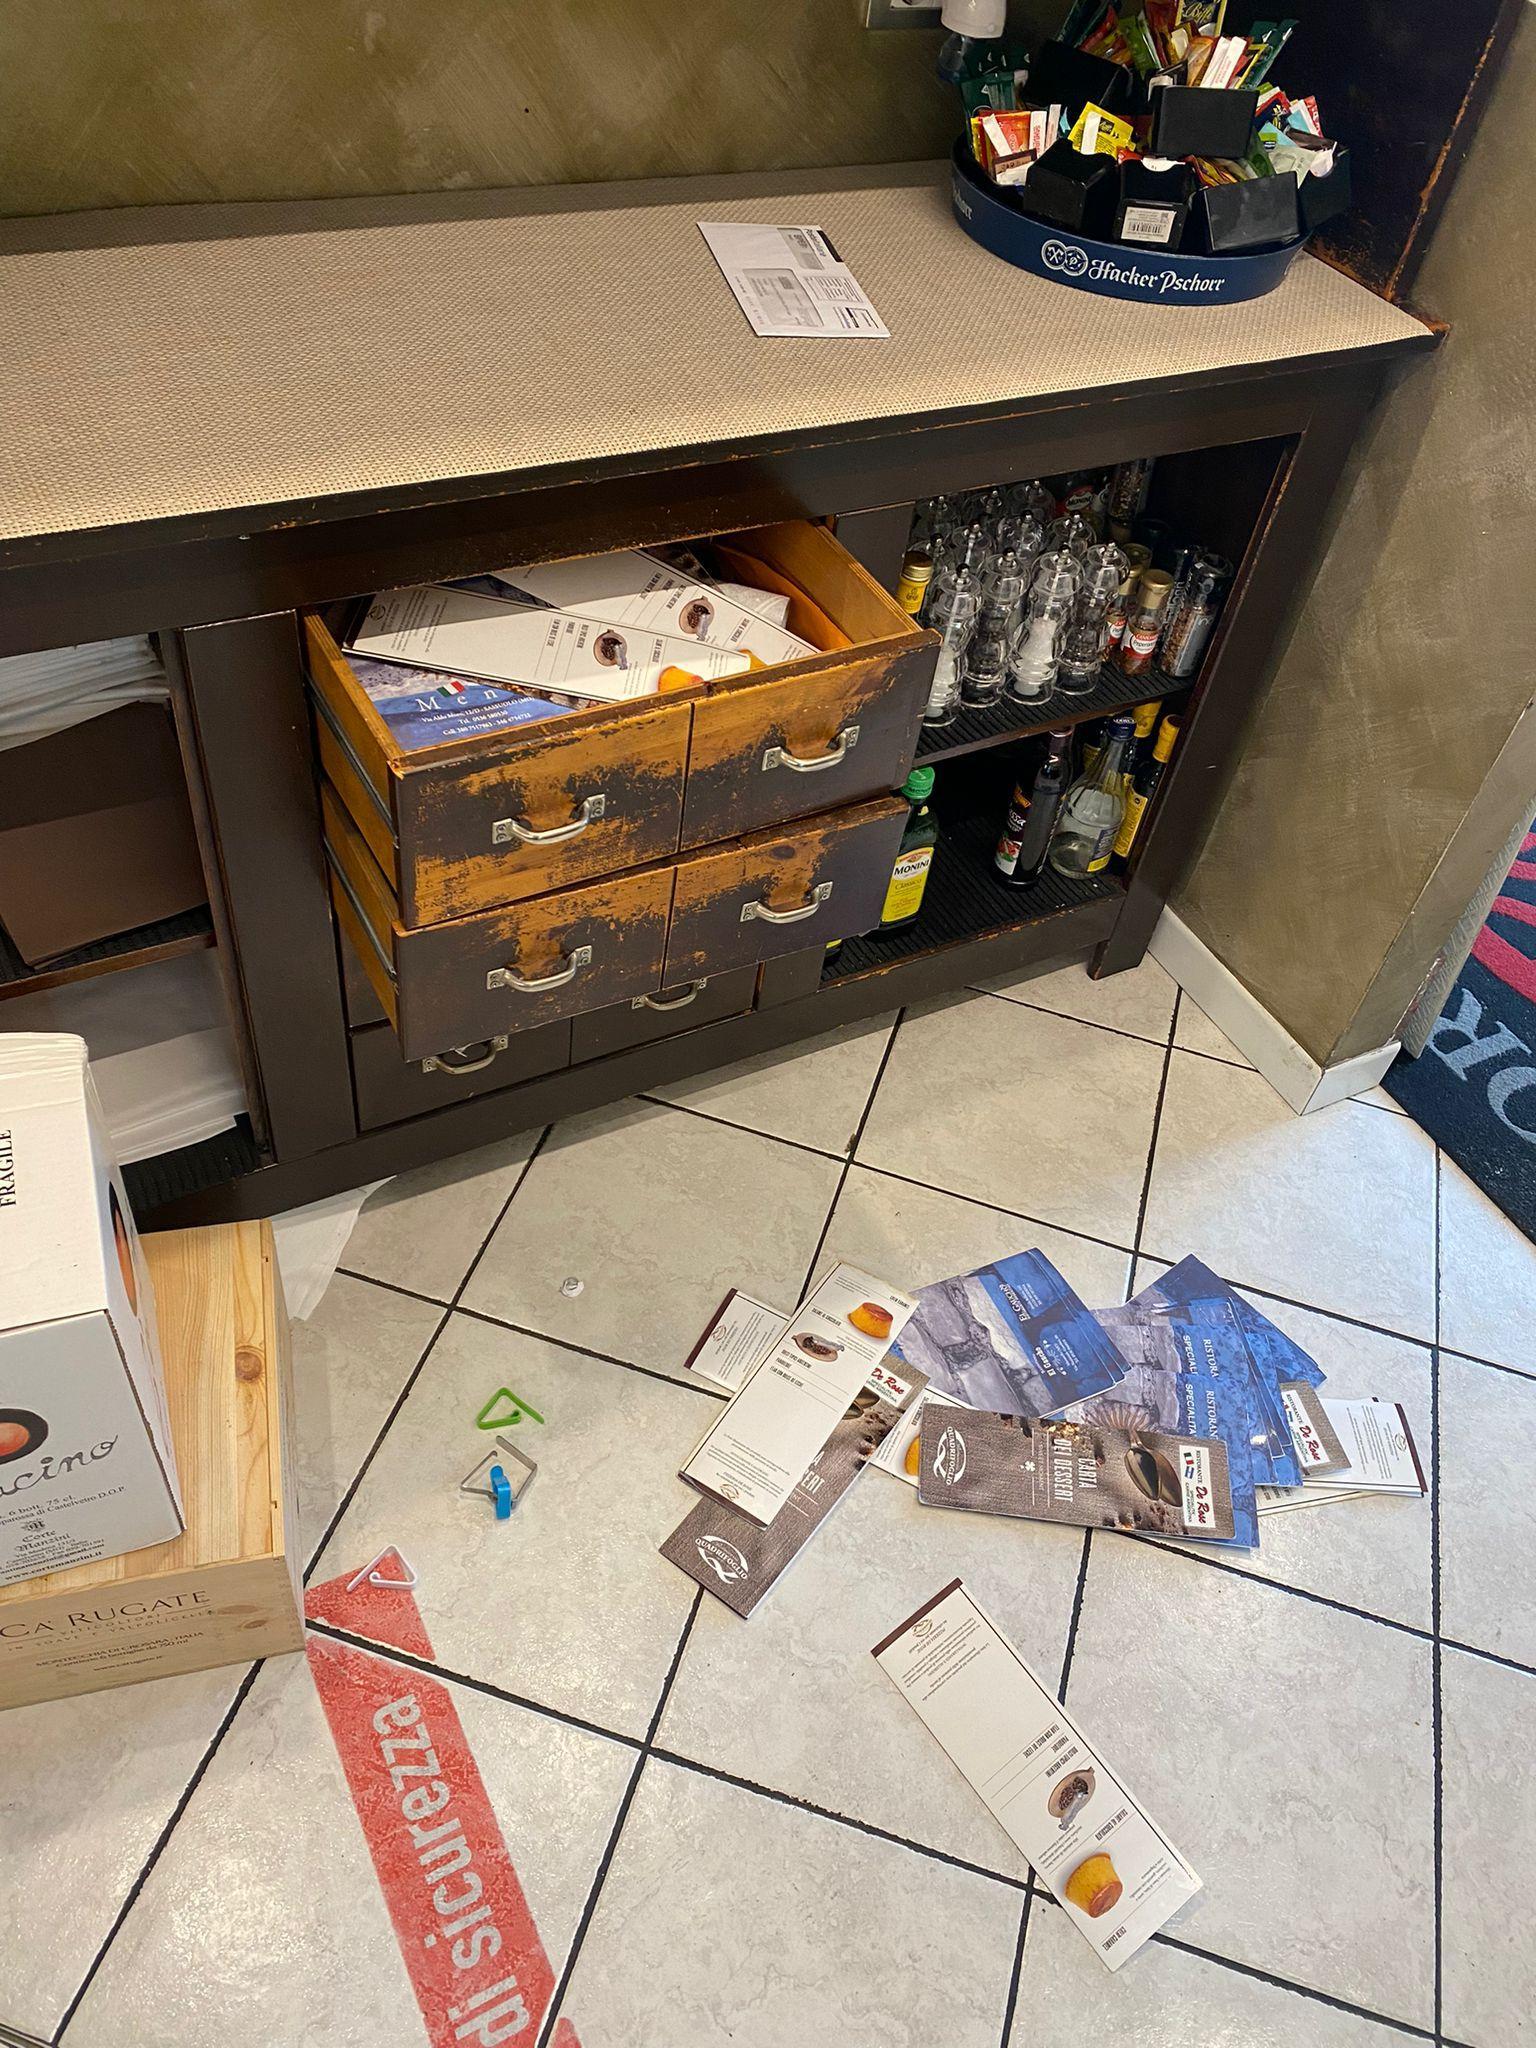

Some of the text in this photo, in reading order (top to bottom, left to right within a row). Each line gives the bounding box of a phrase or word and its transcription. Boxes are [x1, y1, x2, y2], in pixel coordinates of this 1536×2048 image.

[1088, 259, 1226, 294] Hacker Pschorr
[894, 859, 930, 876] MONINI
[0, 1129, 16, 1207] FRAGILE
[871, 1367, 905, 1395] De Rose
[946, 1426, 957, 1486] QUADRIFOGLIO
[1299, 1425, 1311, 1438] De
[1306, 1440, 1321, 1461] Rose
[1053, 1438, 1074, 1503] DEI DESSERT
[1078, 1457, 1098, 1489] CARTA
[1195, 1486, 1208, 1500] De
[1197, 1501, 1210, 1524] Rose
[14, 1533, 71, 1552] Manzini
[22, 1530, 56, 1543] Corte
[695, 1537, 748, 1580] QUADRIFOGLIO
[67, 1591, 211, 1627] RUGATE
[372, 1693, 503, 1970] sicurezza
